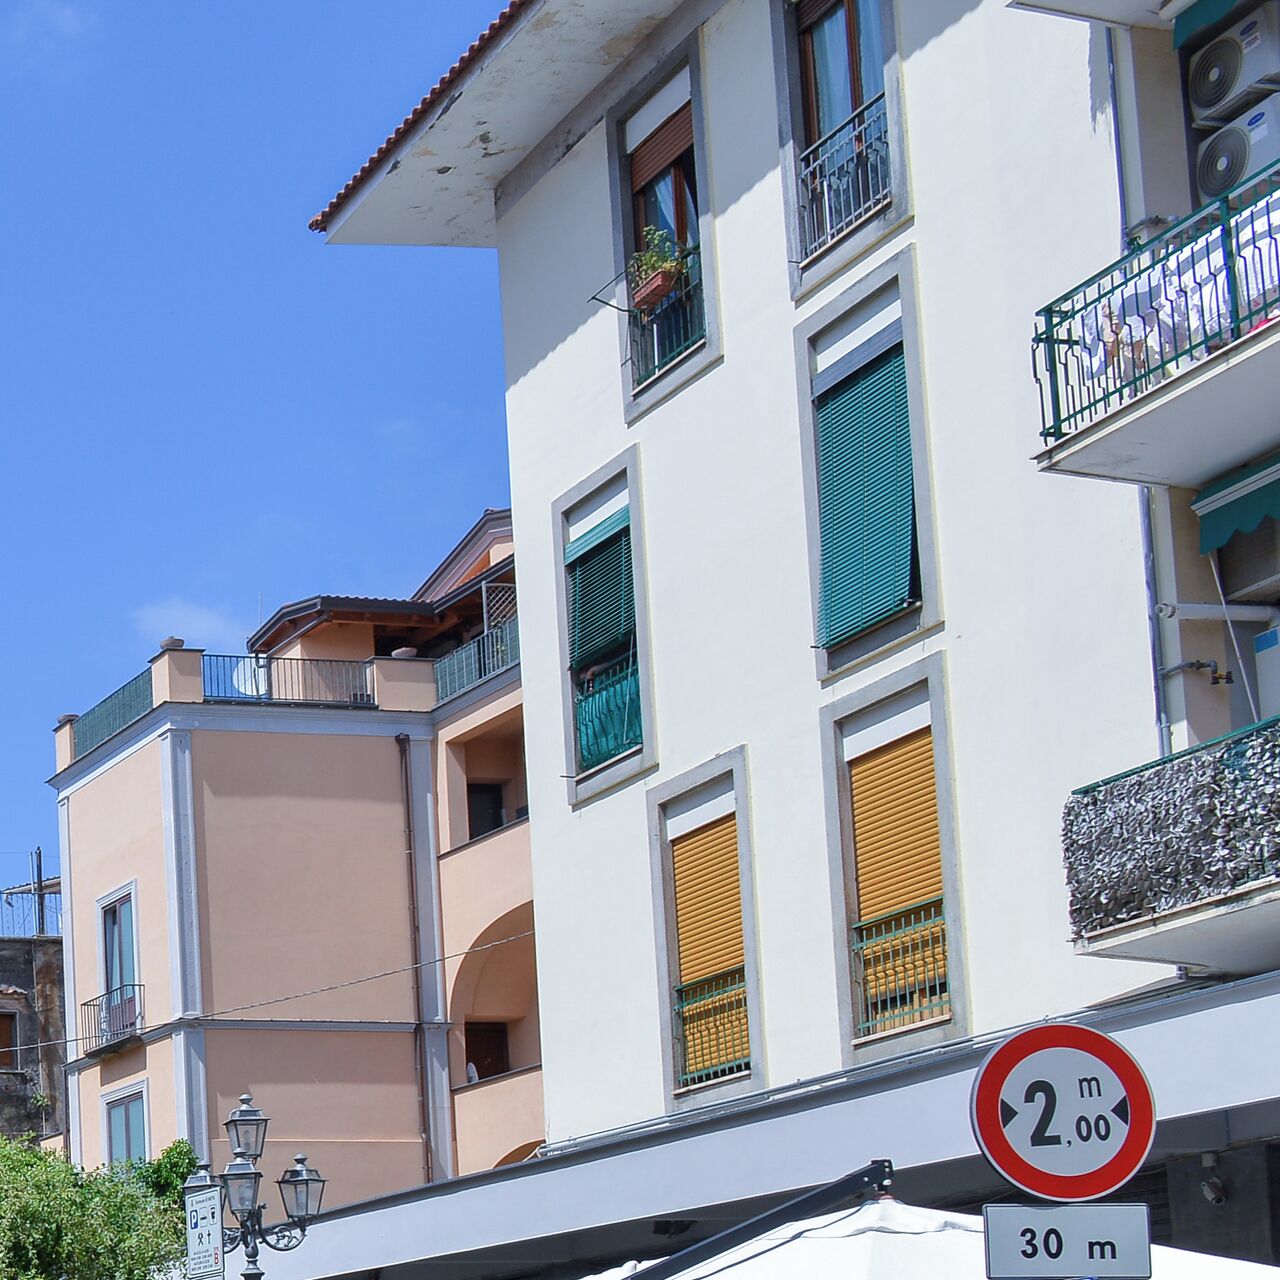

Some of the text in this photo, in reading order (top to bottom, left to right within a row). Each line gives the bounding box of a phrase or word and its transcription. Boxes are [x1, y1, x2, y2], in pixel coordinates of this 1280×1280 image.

[1078, 1076, 1102, 1098] m
[1020, 1228, 1117, 1260] 30 m
